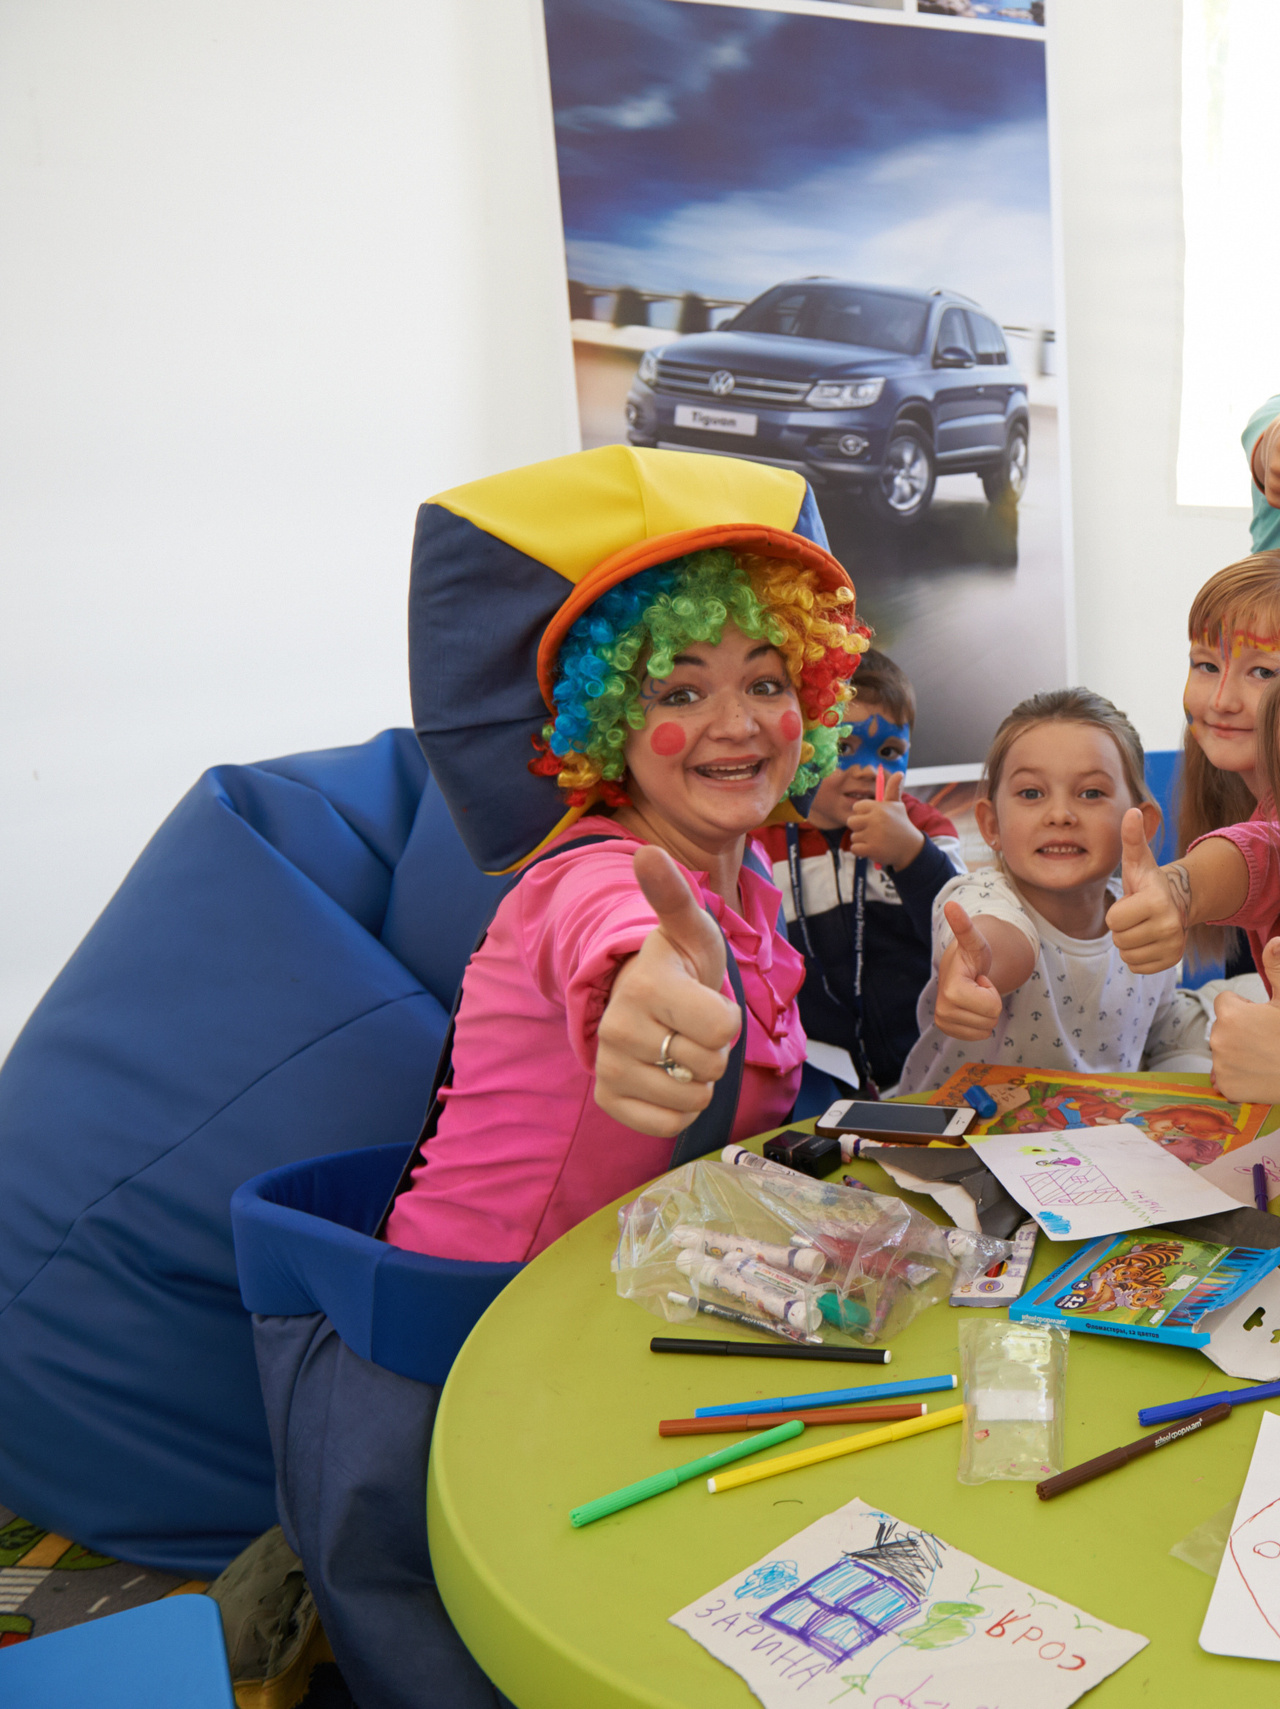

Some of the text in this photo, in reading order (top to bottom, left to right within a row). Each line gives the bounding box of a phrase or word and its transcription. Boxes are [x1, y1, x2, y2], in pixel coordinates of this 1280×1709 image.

[855, 876, 865, 919] Experience
[855, 919, 865, 951] Driving
[1067, 1294, 1084, 1309] 12
[1137, 1330, 1160, 1339] цветов
[695, 1599, 829, 1691] ЗАРИНА
